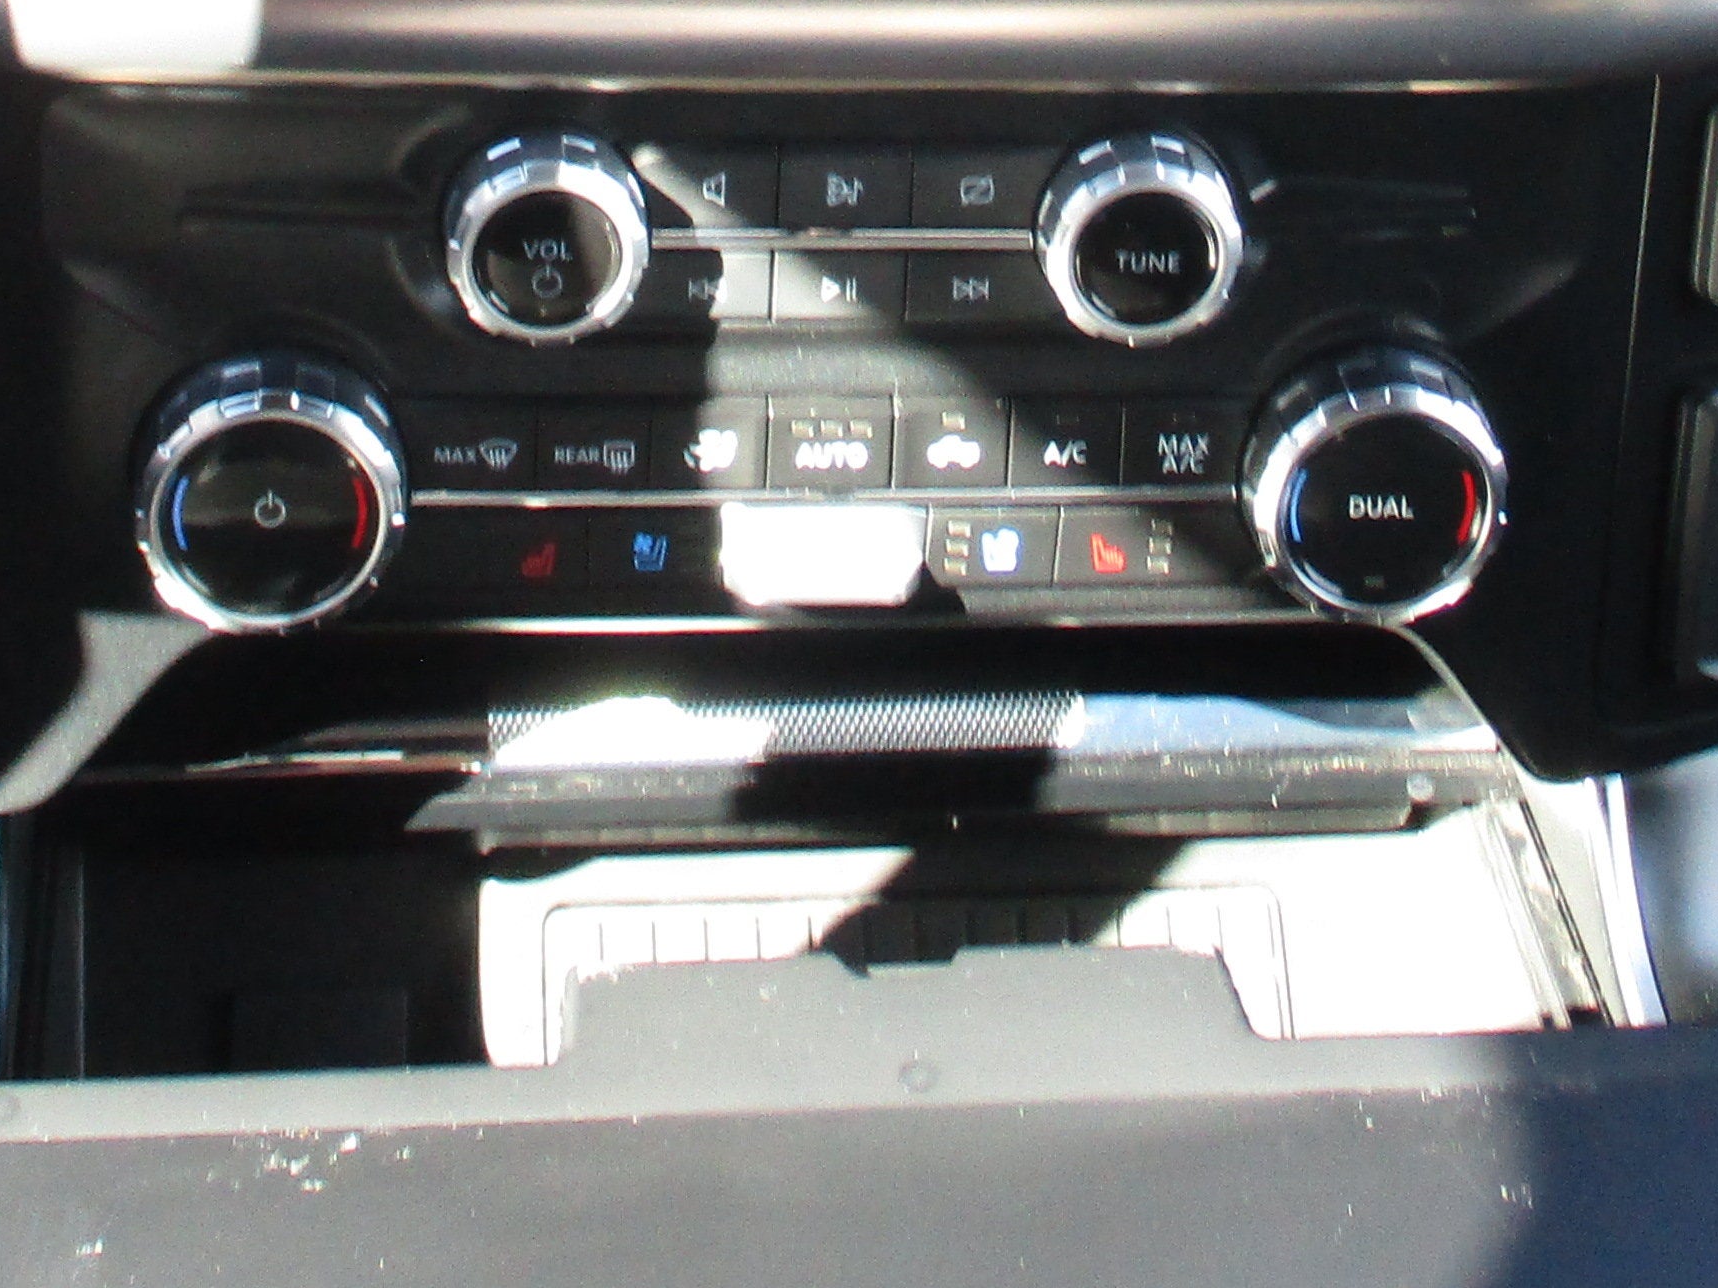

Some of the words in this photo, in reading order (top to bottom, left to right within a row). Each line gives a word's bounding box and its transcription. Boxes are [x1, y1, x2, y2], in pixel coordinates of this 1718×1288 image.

[523, 238, 573, 262] VOL
[1115, 249, 1180, 274] TUNE
[434, 445, 476, 465] MAX
[554, 445, 601, 466] REAR
[794, 441, 870, 469] AUTO
[1043, 439, 1088, 467] A/C
[1158, 432, 1210, 457] MAX
[1162, 454, 1206, 476] A/C
[1348, 493, 1416, 523] DUAL
